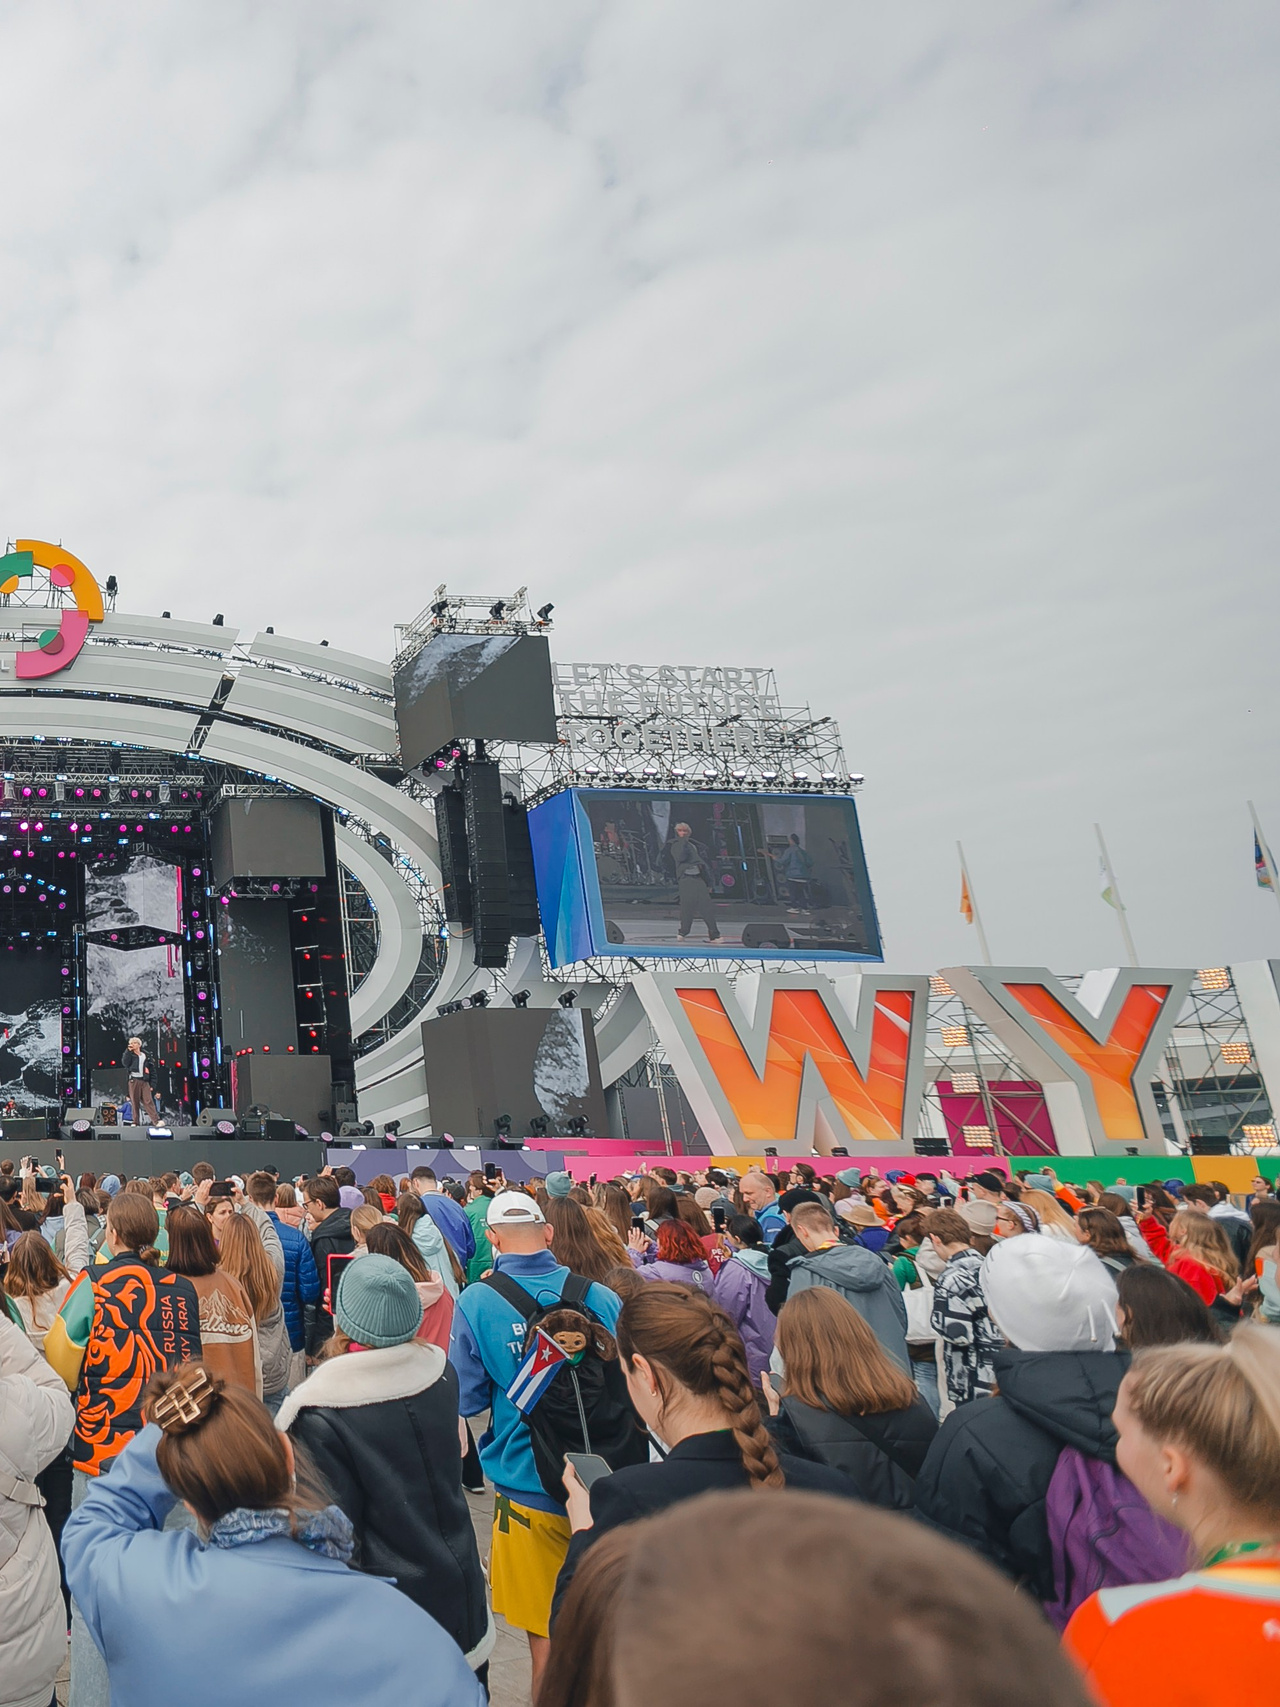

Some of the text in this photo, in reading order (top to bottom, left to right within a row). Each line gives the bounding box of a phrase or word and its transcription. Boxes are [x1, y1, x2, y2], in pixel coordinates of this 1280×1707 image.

[552, 662, 763, 691] LET'S START
[556, 689, 780, 719] THE FUTURE
[561, 723, 767, 753] TOGETHER!
[632, 963, 1280, 1158] WY
[160, 1295, 176, 1353] RUSSIA
[176, 1296, 191, 1362] KIY KRAI
